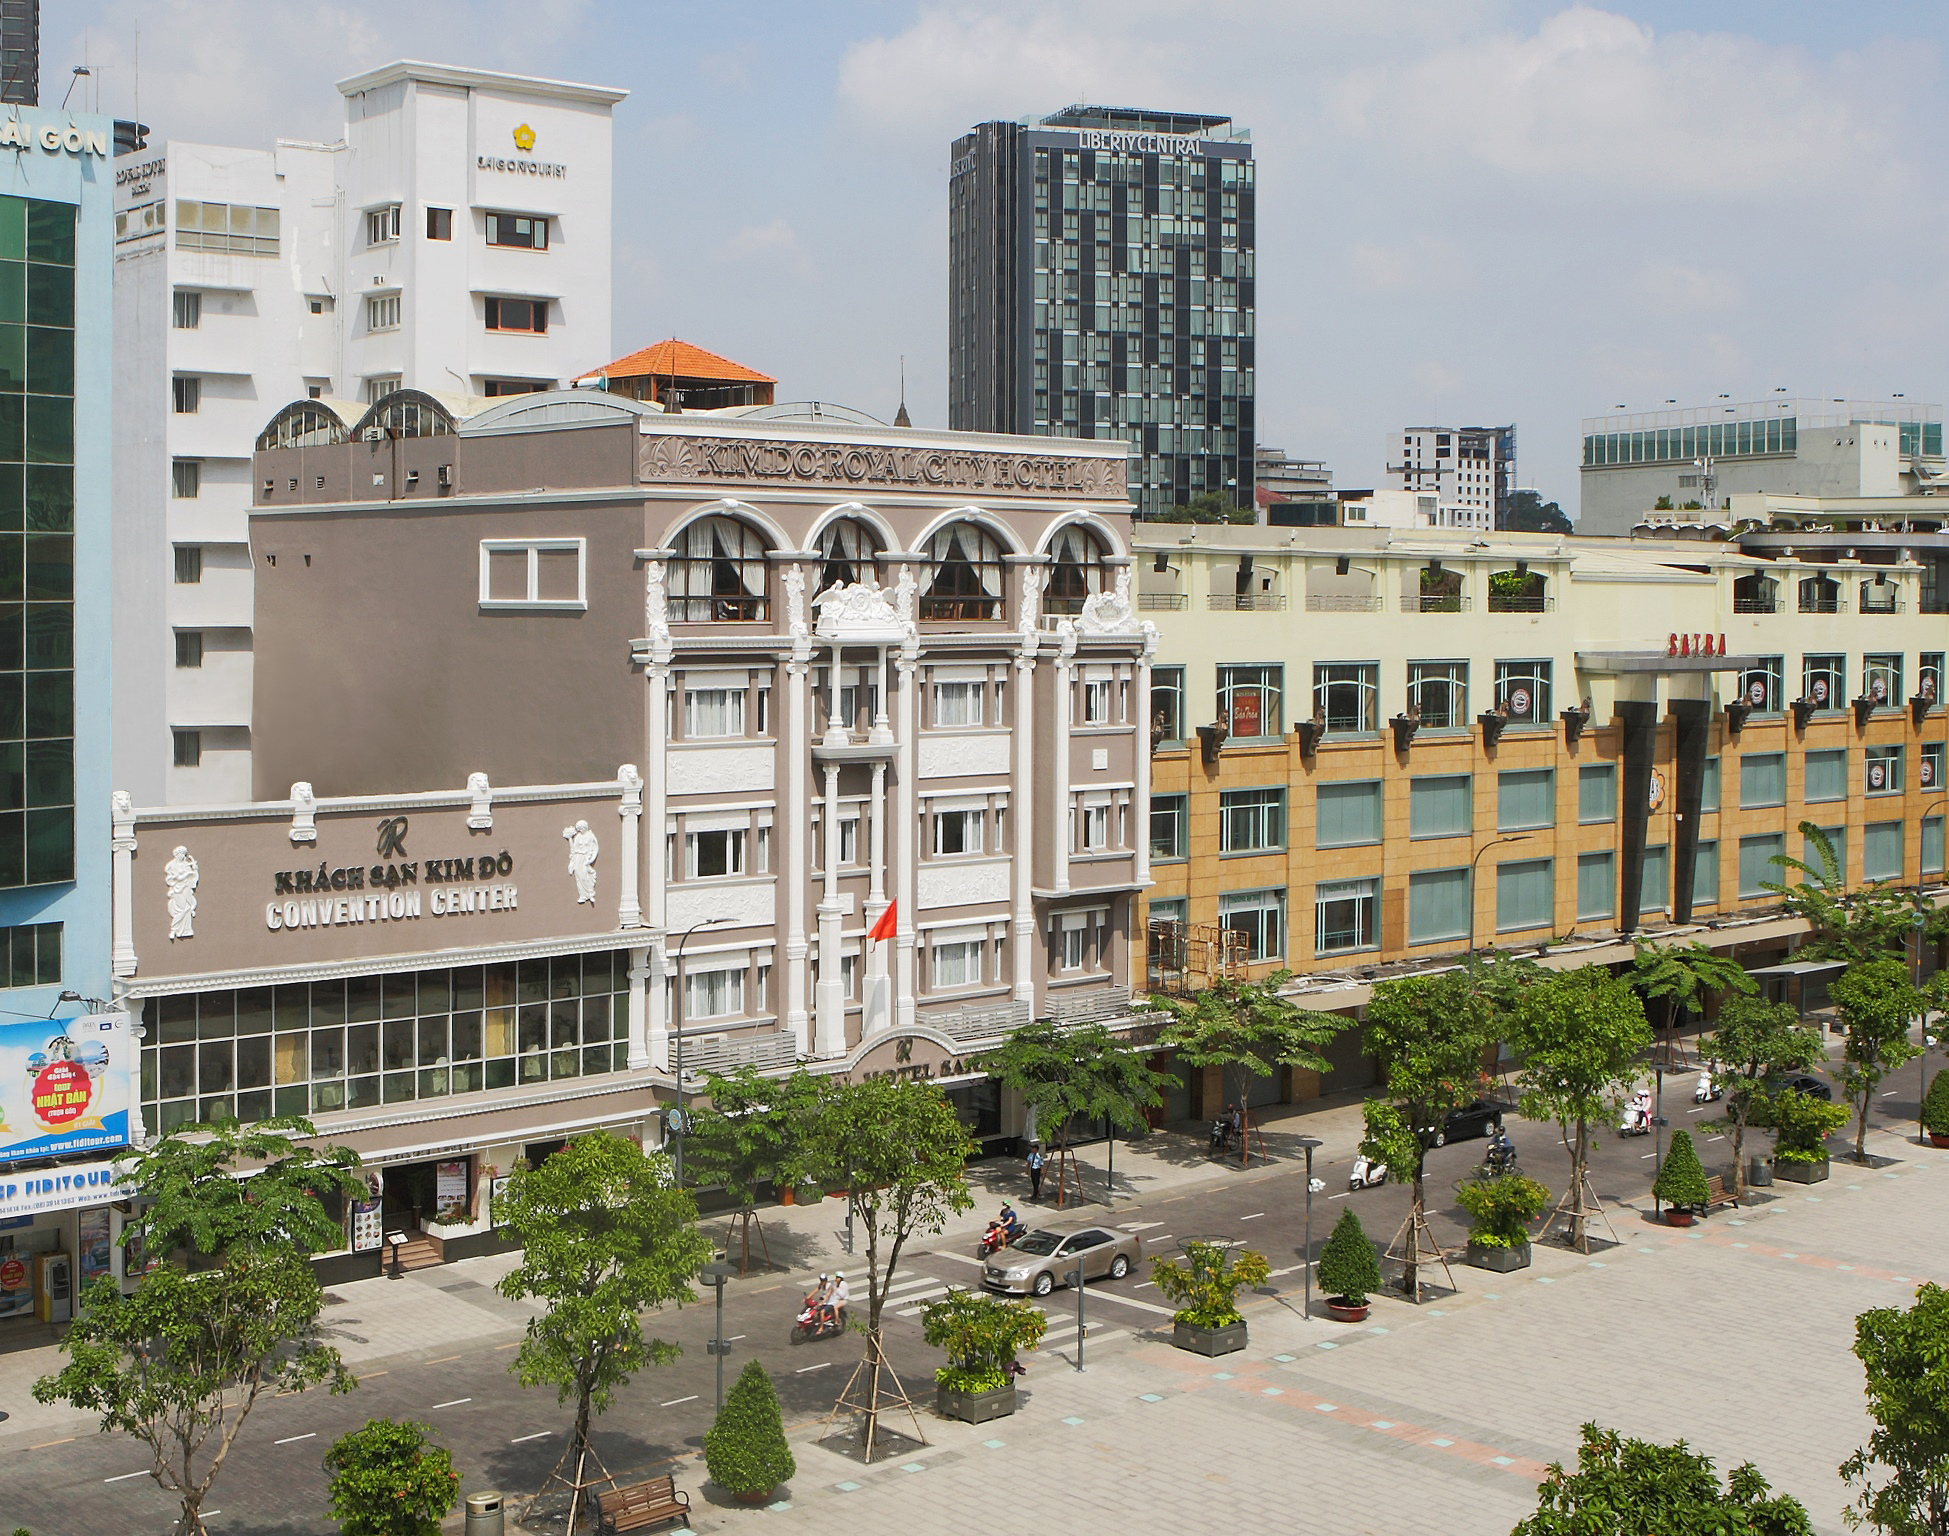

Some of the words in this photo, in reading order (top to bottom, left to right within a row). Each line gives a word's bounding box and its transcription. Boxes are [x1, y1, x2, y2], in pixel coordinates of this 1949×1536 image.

[40, 121, 105, 157] GÒN
[822, 448, 919, 482] ROYAL
[923, 454, 990, 484] CITY
[993, 457, 1084, 489] HOTEL
[1668, 632, 1727, 657] SATRA
[275, 861, 365, 894] KHÁCH
[369, 862, 418, 891] SẠN
[425, 857, 474, 883] KIM
[266, 891, 421, 930] CONVENTION
[431, 884, 518, 916] CENTER
[36, 1093, 64, 1108] NHẬT
[66, 1089, 87, 1105] BẢN
[50, 1135, 123, 1151] www.fiditour.com
[26, 1170, 111, 1198] FIDITOUR
